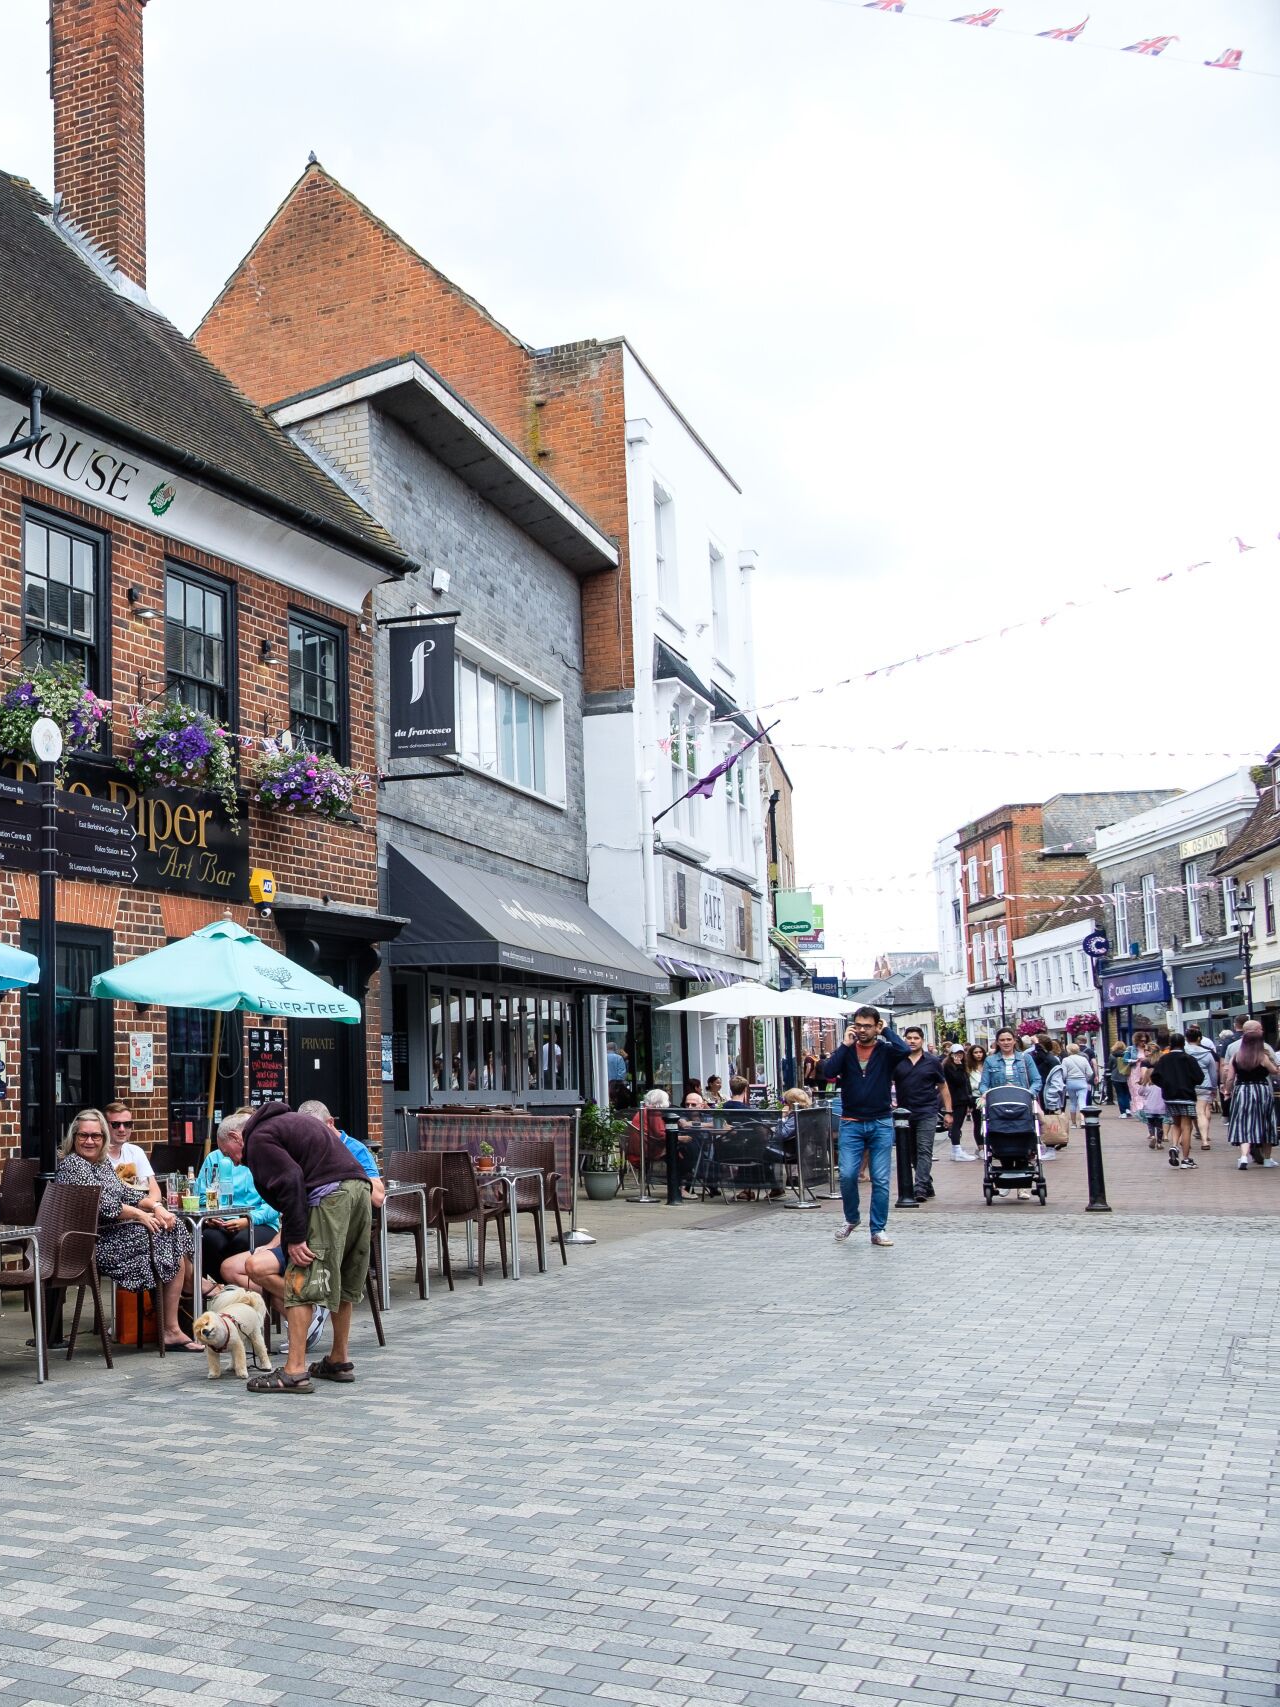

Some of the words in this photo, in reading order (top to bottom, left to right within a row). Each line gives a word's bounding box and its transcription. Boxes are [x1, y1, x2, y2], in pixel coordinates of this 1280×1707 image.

[9, 416, 139, 502] HOUSE
[394, 729, 407, 738] da
[408, 727, 452, 738] francesco
[0, 783, 17, 793] Museum
[100, 805, 112, 814] Centre
[108, 780, 213, 852] Piper
[79, 820, 87, 828] East
[88, 822, 104, 831] Berkshire
[105, 826, 119, 835] College
[11, 831, 26, 840] Centre
[95, 845, 106, 853] Police
[106, 847, 119, 855] Station
[157, 844, 192, 880] Art
[197, 852, 237, 887] Bar
[103, 868, 120, 878] Shopping
[814, 983, 837, 991] RUSH
[1116, 985, 1131, 996] CANCER
[1132, 982, 1152, 994] RESEARCH
[258, 996, 349, 1015] FEVER-TREE
[301, 1037, 336, 1050] PRIVATE
